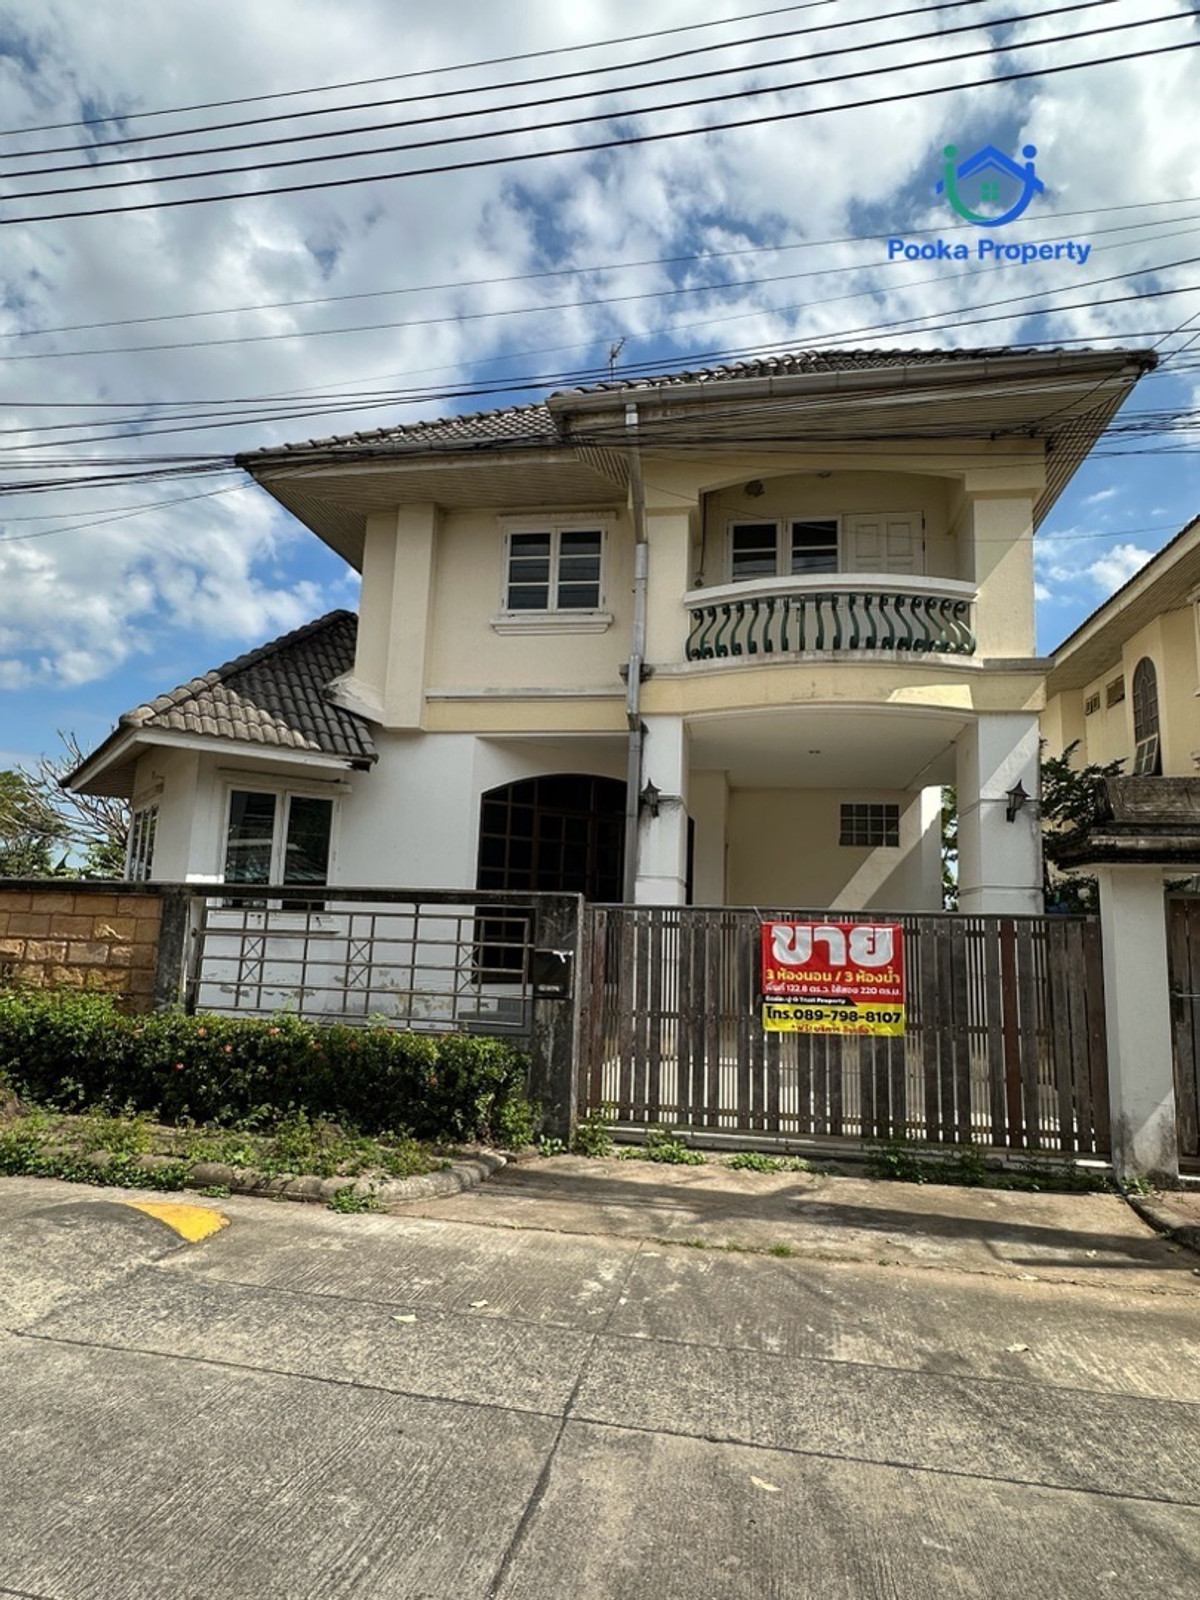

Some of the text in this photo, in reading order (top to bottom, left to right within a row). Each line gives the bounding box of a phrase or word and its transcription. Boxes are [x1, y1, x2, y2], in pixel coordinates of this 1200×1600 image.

[771, 925, 893, 967] ขาย
[767, 966, 900, 984] 3 ห้องนอน / 3 ห้องน้ำ
